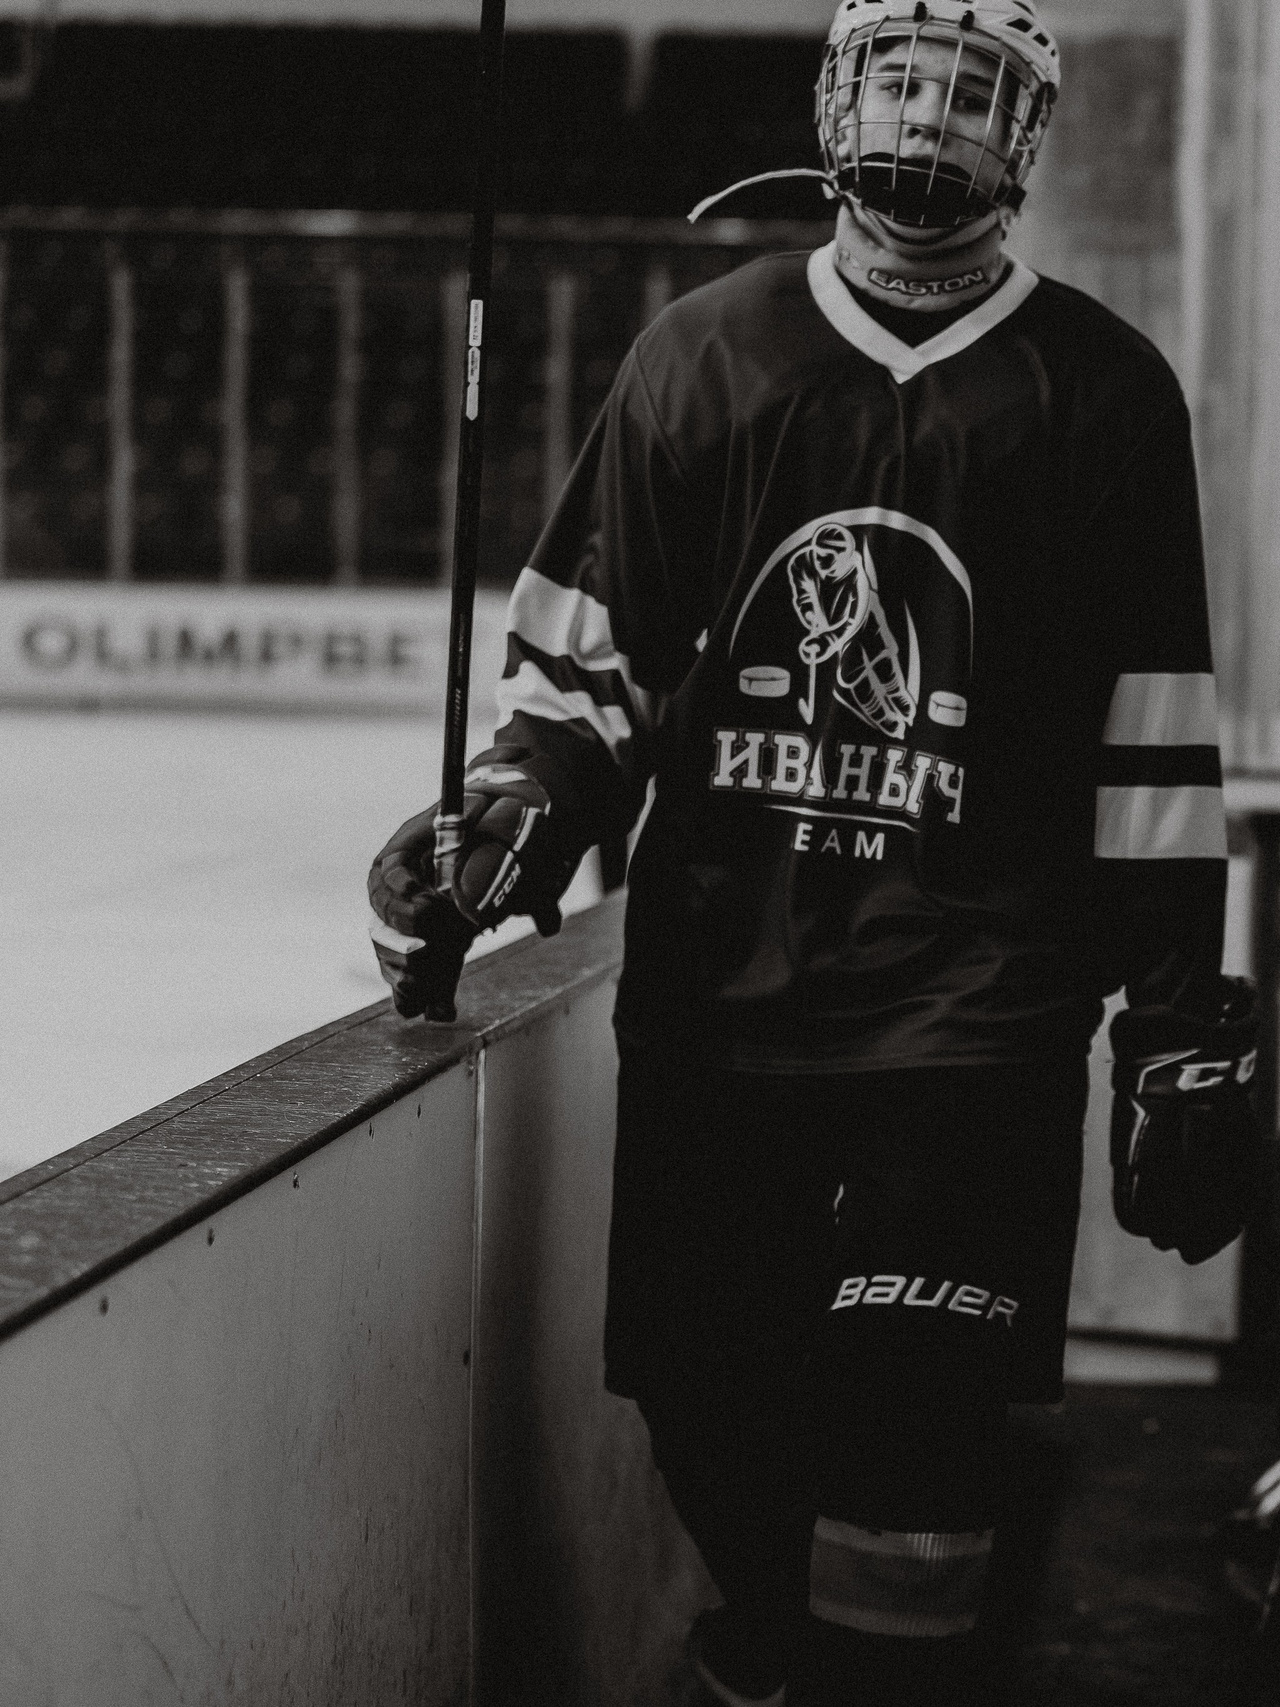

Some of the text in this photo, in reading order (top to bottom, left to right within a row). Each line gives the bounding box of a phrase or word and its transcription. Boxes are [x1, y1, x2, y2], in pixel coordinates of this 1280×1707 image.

[869, 269, 984, 295] EASTON
[20, 616, 425, 676] OLIMPBE
[794, 822, 886, 861] EAM
